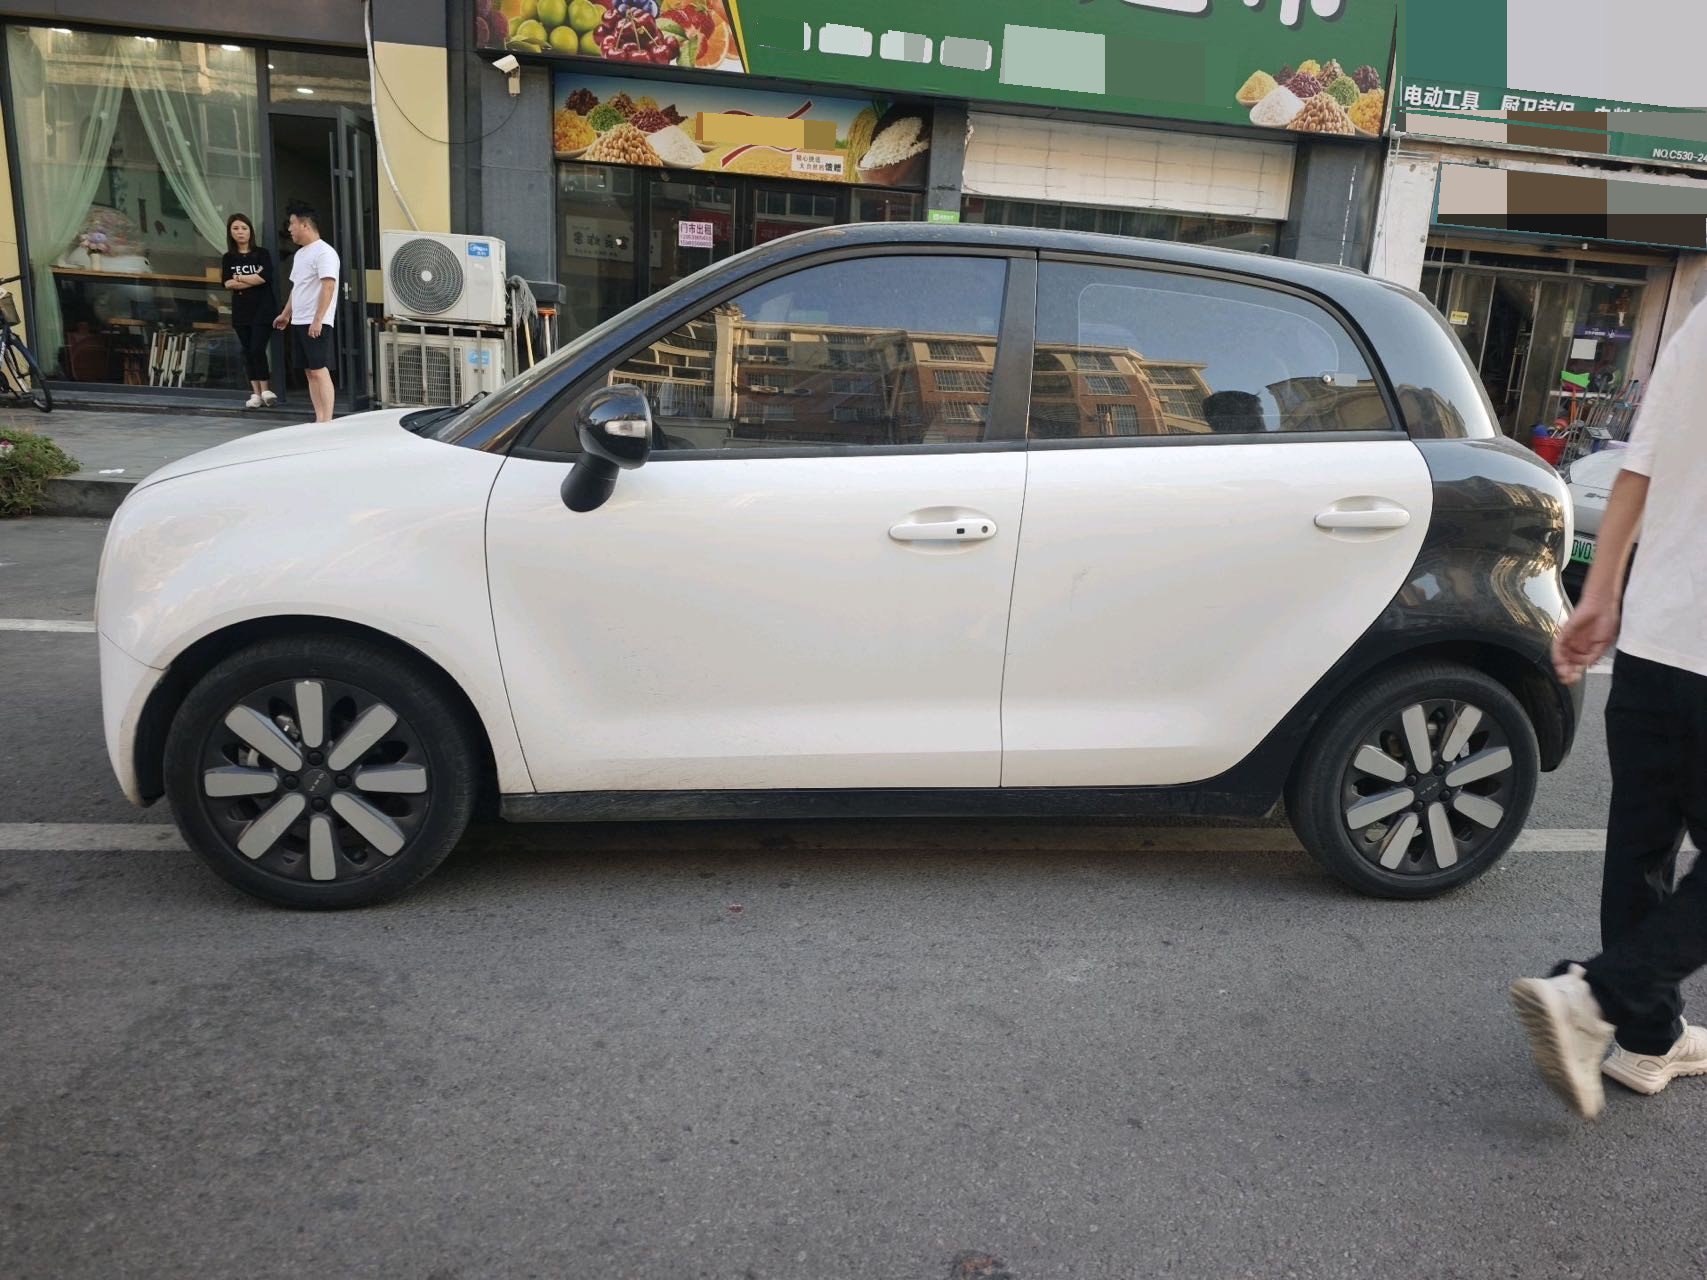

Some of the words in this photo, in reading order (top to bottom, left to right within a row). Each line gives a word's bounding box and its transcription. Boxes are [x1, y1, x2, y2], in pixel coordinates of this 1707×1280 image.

[1404, 84, 1480, 110] 电动工具
[680, 222, 712, 235] 门市出租
